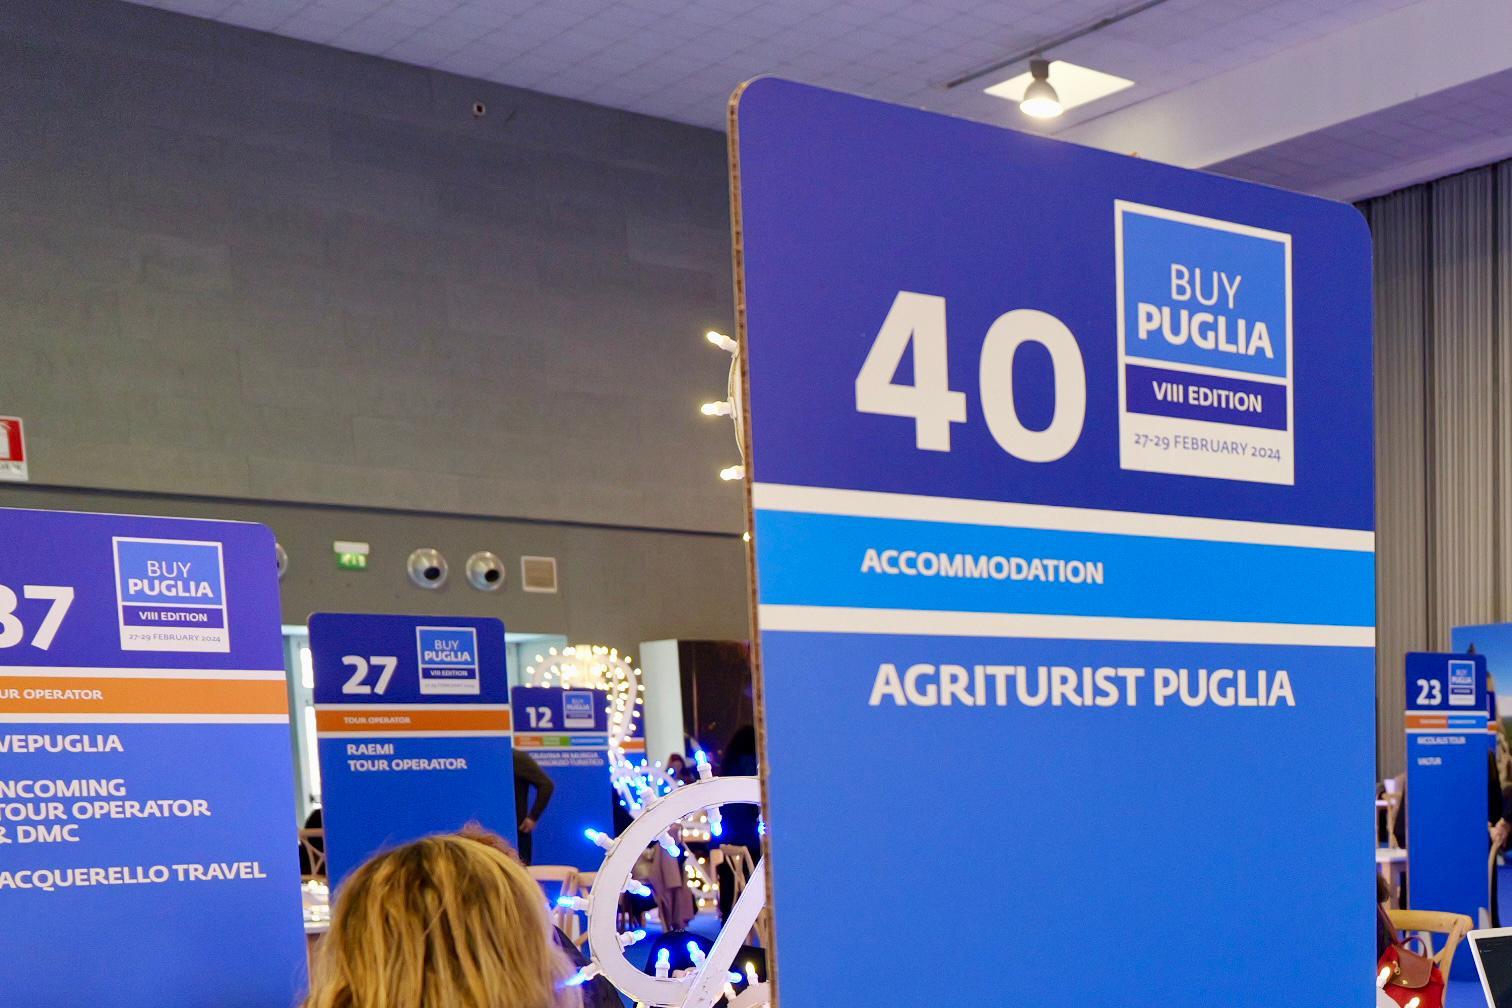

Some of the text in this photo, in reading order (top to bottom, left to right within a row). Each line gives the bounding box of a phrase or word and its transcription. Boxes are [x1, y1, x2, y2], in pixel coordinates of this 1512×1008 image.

[1170, 262, 1242, 308] BUY
[1137, 303, 1274, 359] PUGLIA
[855, 290, 1087, 463] 40
[1152, 380, 1263, 413] VIII EDITION
[1133, 431, 1282, 463] 27-29 FEBRUARY 2024
[147, 560, 191, 578] BUY
[860, 548, 1105, 585] ACCOMMODATION
[128, 577, 214, 599] PUGLIA
[138, 610, 208, 623] VIII EDITION
[152, 632, 200, 643] FEBRUARY
[434, 639, 459, 651] BUY
[424, 650, 472, 662] PUGLIA
[341, 655, 398, 695] 27
[868, 663, 1297, 708] AGRITURIST PUGLIA
[23, 689, 104, 700] OPERATOR
[1416, 678, 1442, 706] 23
[526, 706, 554, 728] 12
[346, 743, 394, 756] RAEMI
[347, 757, 468, 771] TOUR OPERATOR
[72, 799, 211, 820] OPERATOR
[17, 824, 80, 844] DMC
[0, 861, 267, 892] ACQUERELLO TRAVEL
